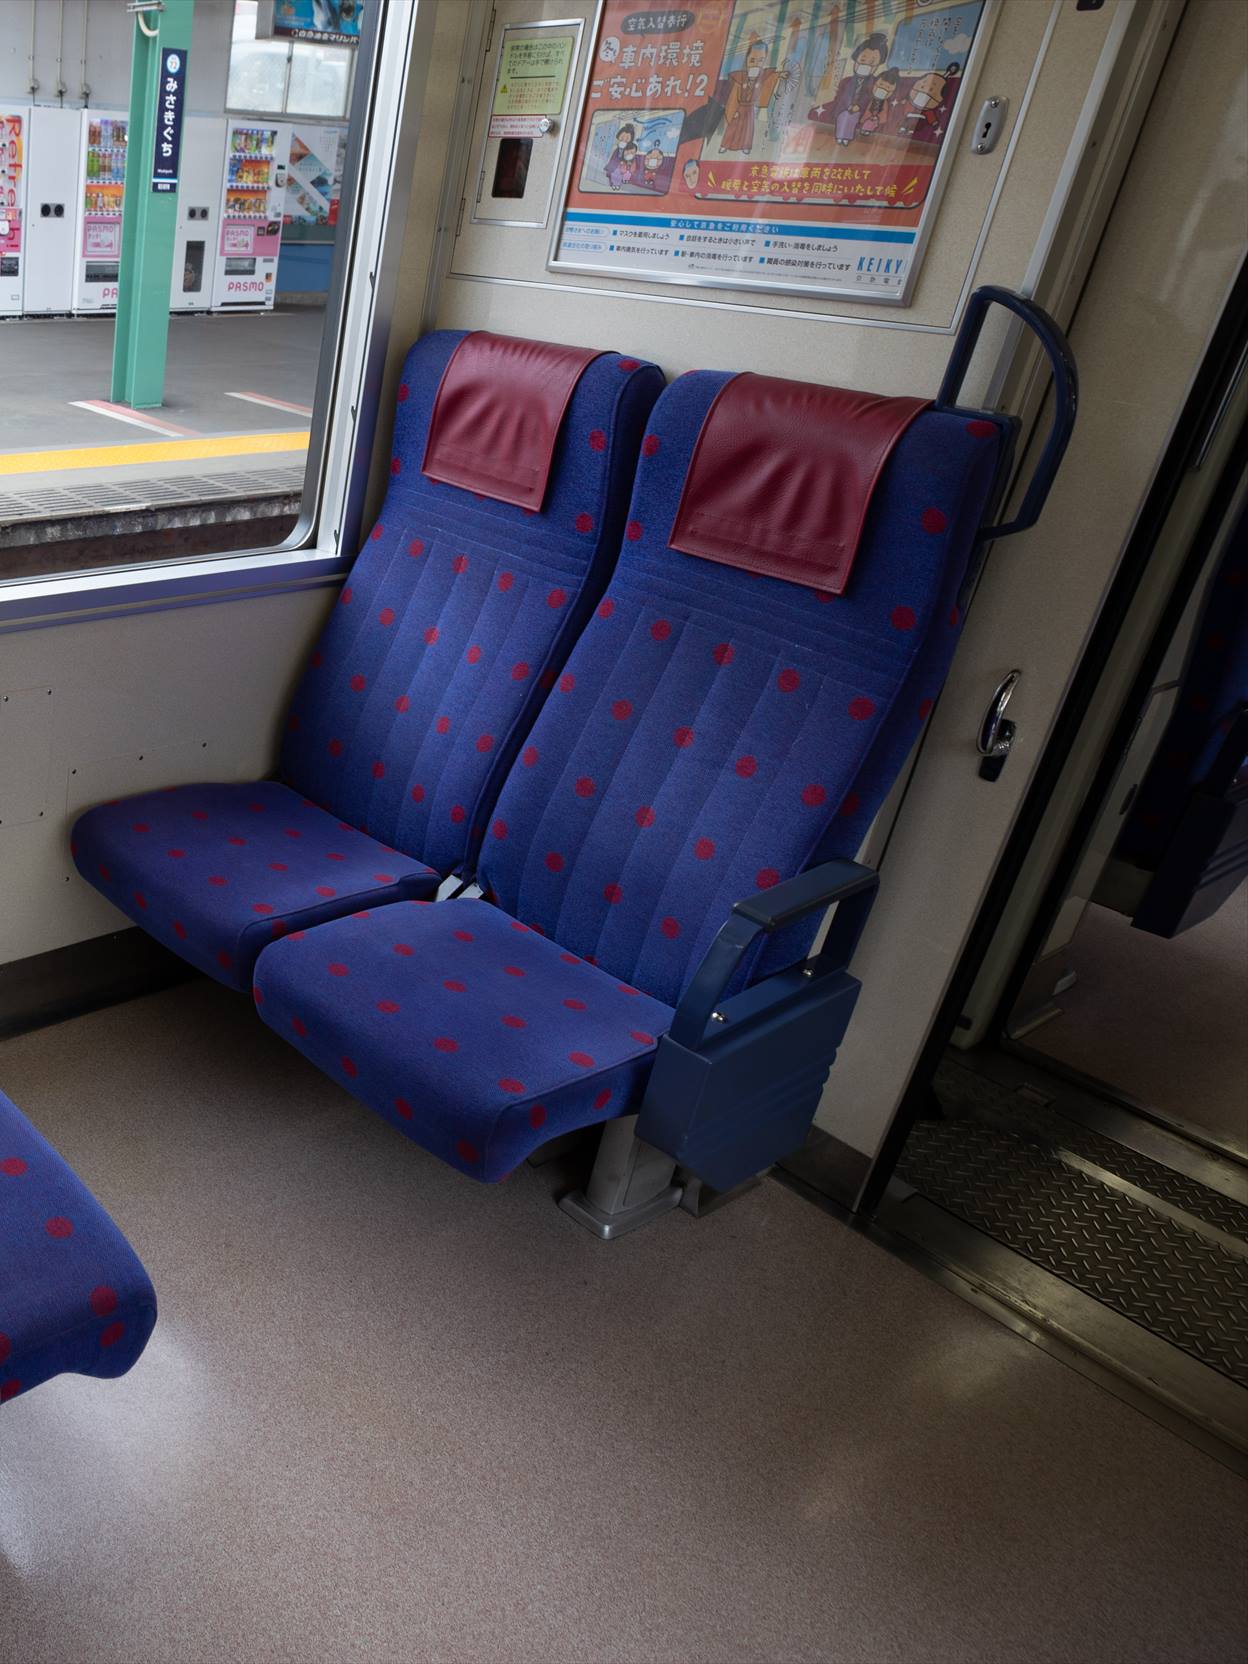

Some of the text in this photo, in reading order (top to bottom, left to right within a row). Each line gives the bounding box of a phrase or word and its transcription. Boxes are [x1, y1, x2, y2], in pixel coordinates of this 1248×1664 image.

[619, 40, 704, 69] 車内環境
[161, 77, 178, 157] みさきぐち
[857, 256, 904, 274] KEIKY
[102, 288, 119, 299] PA
[228, 280, 264, 293] PASMO
